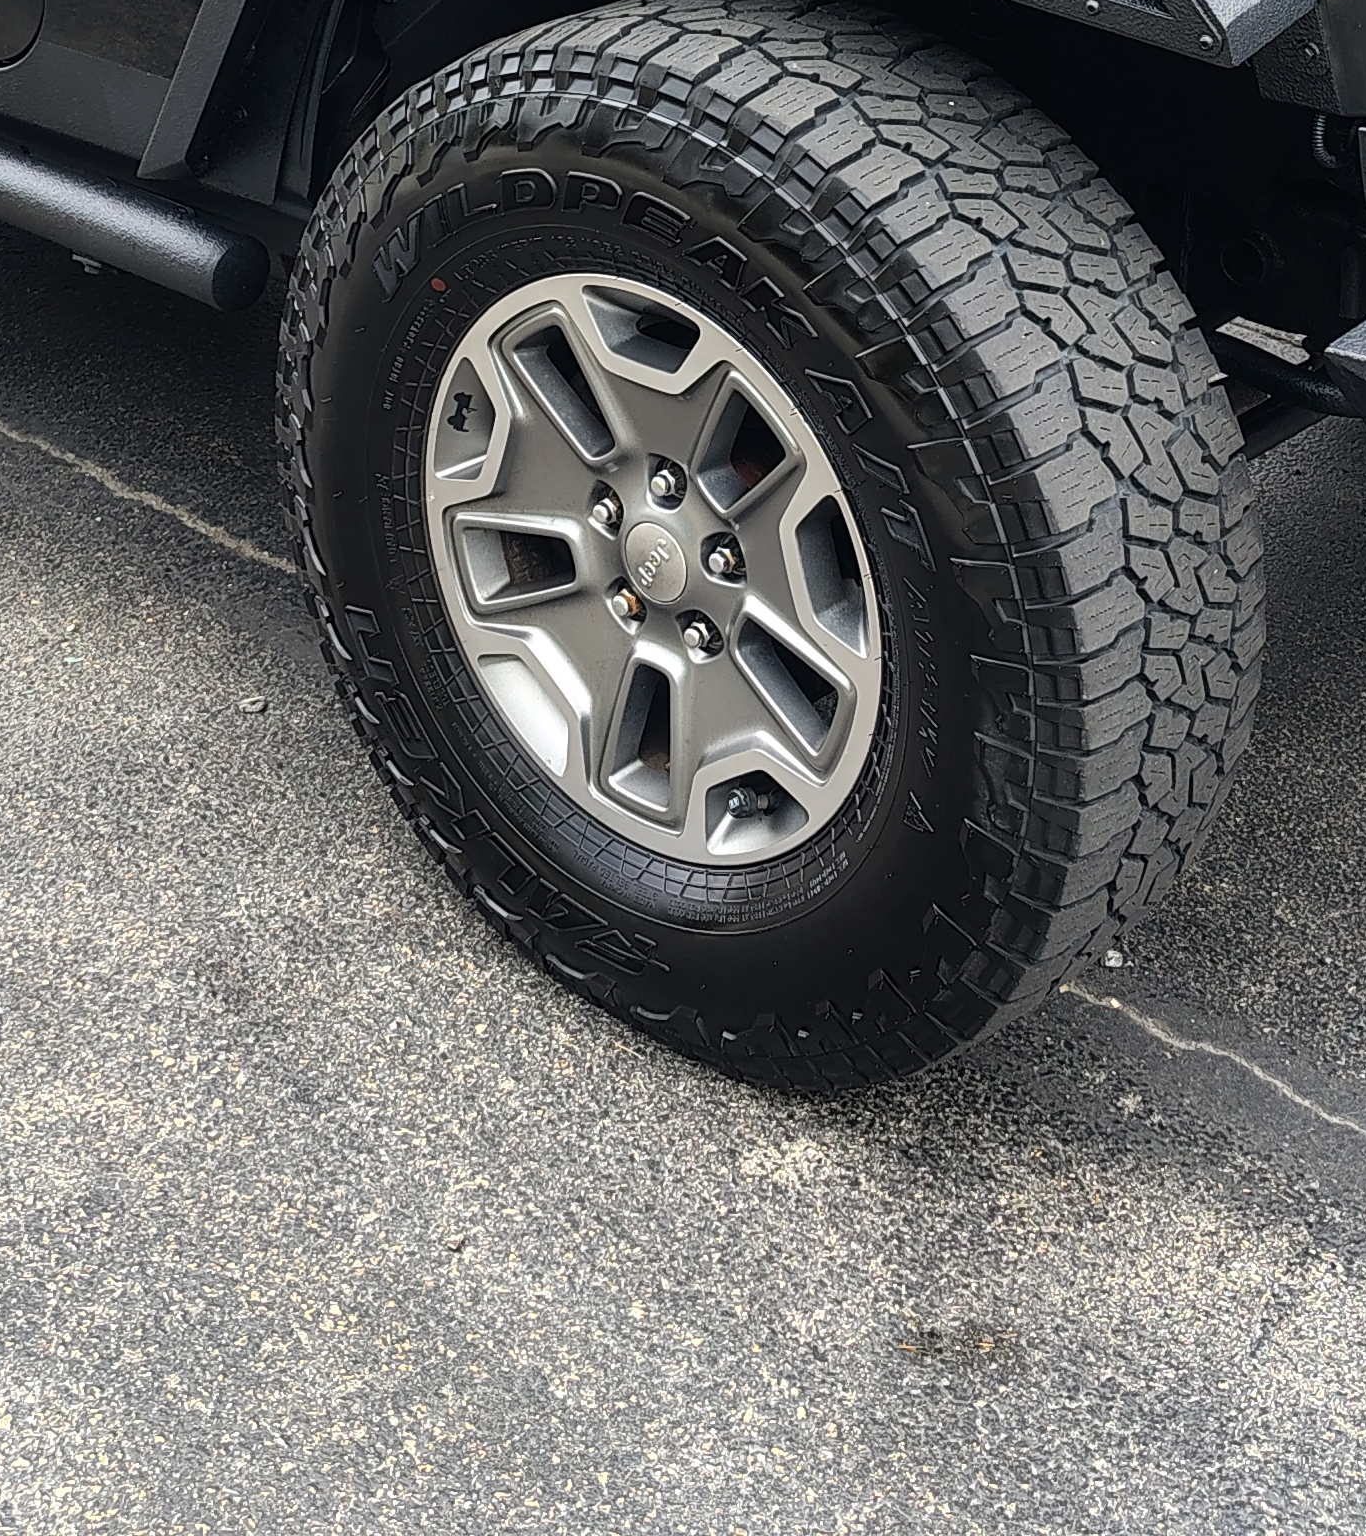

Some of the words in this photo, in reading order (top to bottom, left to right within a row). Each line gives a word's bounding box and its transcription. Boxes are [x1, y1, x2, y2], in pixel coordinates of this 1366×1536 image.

[371, 167, 819, 350] WILDPEAK
[637, 538, 671, 590] Jeep
[343, 604, 672, 976] FALKEN
